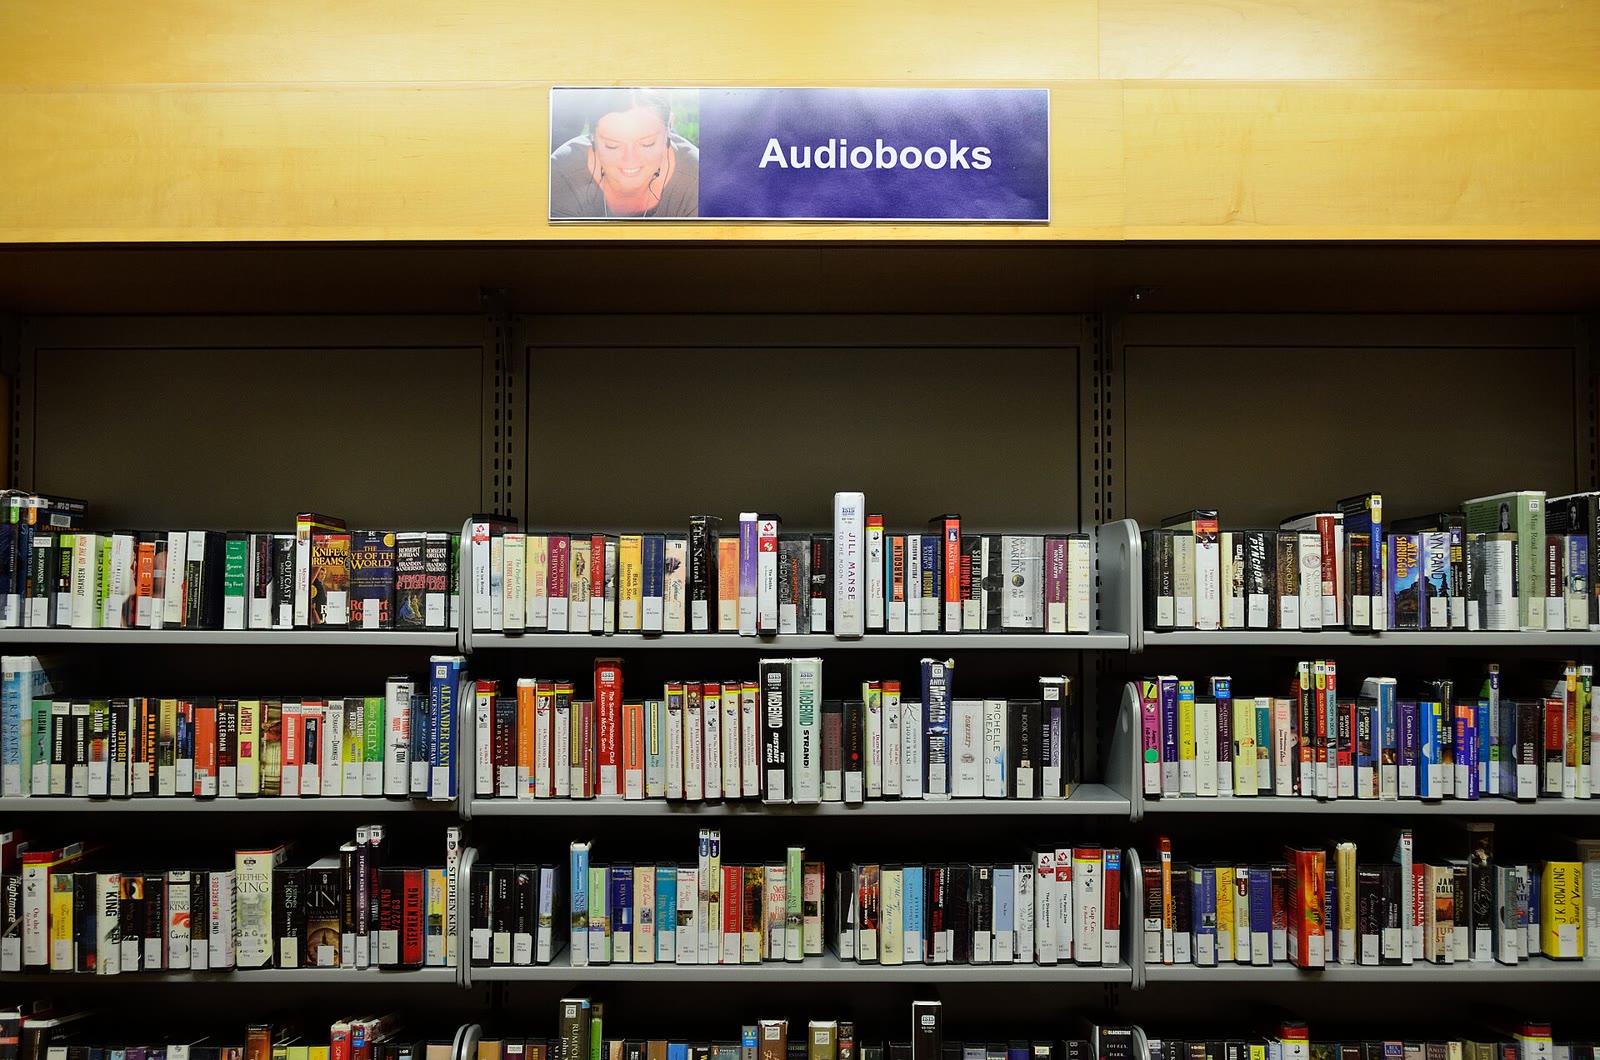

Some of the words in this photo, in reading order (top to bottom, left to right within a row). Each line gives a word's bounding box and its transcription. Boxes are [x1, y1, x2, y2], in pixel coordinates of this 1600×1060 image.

[759, 139, 992, 170] Audiobooks
[1530, 514, 1539, 530] Miss
[693, 526, 703, 544] The
[839, 532, 844, 540] TO
[848, 533, 856, 556] JILL
[1258, 533, 1266, 559] THOMAS
[1430, 533, 1444, 549] AYN
[1530, 533, 1538, 549] Read
[312, 547, 340, 556] KNIFE
[972, 550, 981, 565] LIES
[1011, 538, 1020, 573] MARTIN
[1250, 538, 1263, 583] PYNCHON
[1396, 537, 1407, 579] SHRUGGED
[1407, 544, 1417, 568] ATLAS
[62, 551, 70, 577] JOHANSEN
[143, 558, 151, 578] EVE
[351, 560, 391, 569] WORLD
[693, 549, 703, 582] Natural
[894, 546, 903, 583] MARGOLIN
[960, 555, 970, 586] MARTINI
[972, 567, 981, 575] OF
[1430, 553, 1444, 580] RAND
[77, 568, 85, 596] JOHANSEN
[284, 561, 292, 598] OUTCAST
[848, 562, 856, 600] MANSE
[368, 701, 378, 720] Cathy
[440, 684, 450, 740] ALEXANDER
[768, 692, 783, 728] McDERMID
[800, 690, 814, 726] McDERMID
[930, 686, 945, 722] McNAB
[38, 710, 46, 734] TWISTED
[94, 710, 103, 732] MOTIVE
[219, 713, 227, 752] KELLERMAN
[240, 707, 252, 735] THERAPY
[432, 717, 438, 726] TO
[495, 719, 503, 740] Sung
[118, 731, 126, 761] TBOILER
[368, 721, 377, 751] KELLY
[1022, 734, 1028, 742] OF
[396, 751, 405, 763] TOM
[440, 742, 450, 767] KENT
[930, 737, 945, 764] FIREWA
[237, 882, 269, 892] KING
[1221, 871, 1230, 888] Valley
[1553, 868, 1566, 905] ROWLING
[1571, 868, 1580, 900] Vacancy
[8, 878, 19, 922] nightmare
[106, 892, 117, 916] KING
[286, 888, 294, 908] KING
[381, 889, 390, 907] KING
[406, 888, 418, 907] KING
[659, 895, 668, 909] FERN
[1148, 888, 1161, 918] TRIBUTE
[34, 908, 40, 917] On
[1587, 907, 1596, 917] AND
[170, 930, 189, 940] Carrie
[406, 911, 418, 946] STEPHEN
[562, 1037, 570, 1053] John
